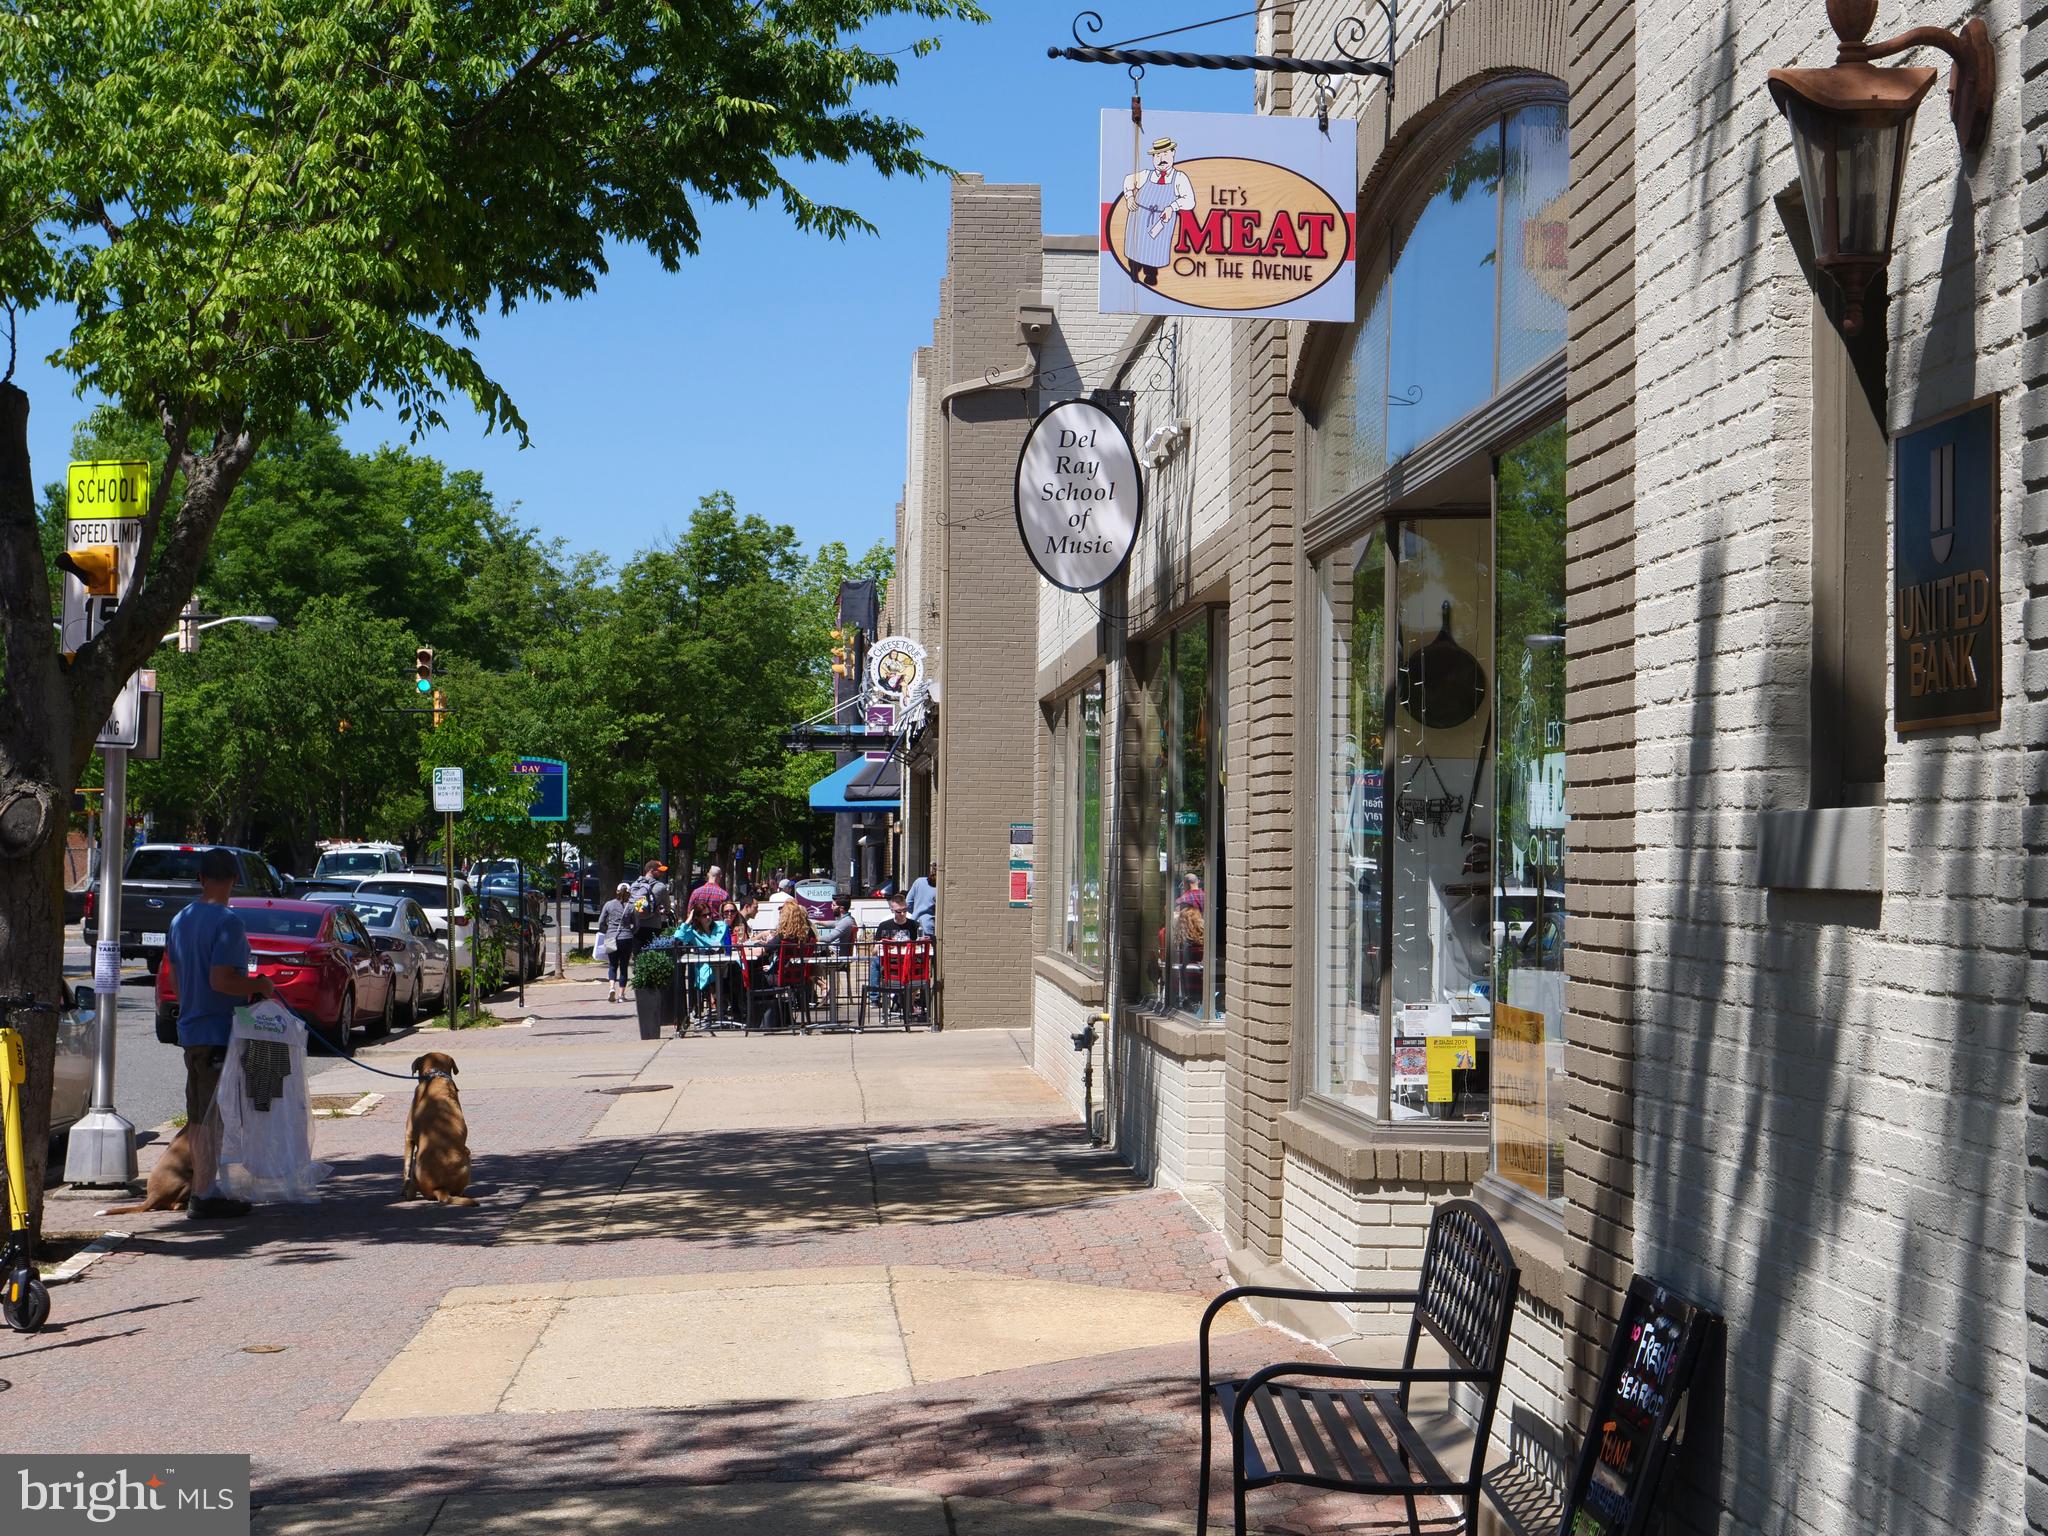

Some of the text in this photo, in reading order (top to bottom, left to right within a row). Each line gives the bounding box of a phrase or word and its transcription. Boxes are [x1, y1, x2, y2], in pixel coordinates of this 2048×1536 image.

[1210, 185, 1247, 206] LET'S
[1174, 209, 1335, 258] MEAT
[1216, 259, 1244, 278] THE
[1252, 260, 1313, 281] AVENUE
[1059, 429, 1096, 448] Del
[1055, 456, 1100, 480] Ray
[77, 477, 138, 503] SCHOOL
[1041, 482, 1116, 501] School
[1068, 507, 1092, 533] of
[73, 523, 141, 543] SPEED LIMIT
[1045, 535, 1113, 554] Music
[1898, 569, 1989, 640] UNITED
[873, 640, 921, 659] CHEESETIQUE
[1909, 632, 1977, 696] BANK
[435, 771, 442, 782] 2
[521, 765, 540, 773] RAY
[1634, 1323, 1675, 1385] FRESH
[1617, 1371, 1664, 1416] SEAFOOD
[1599, 1420, 1632, 1473] TUNA
